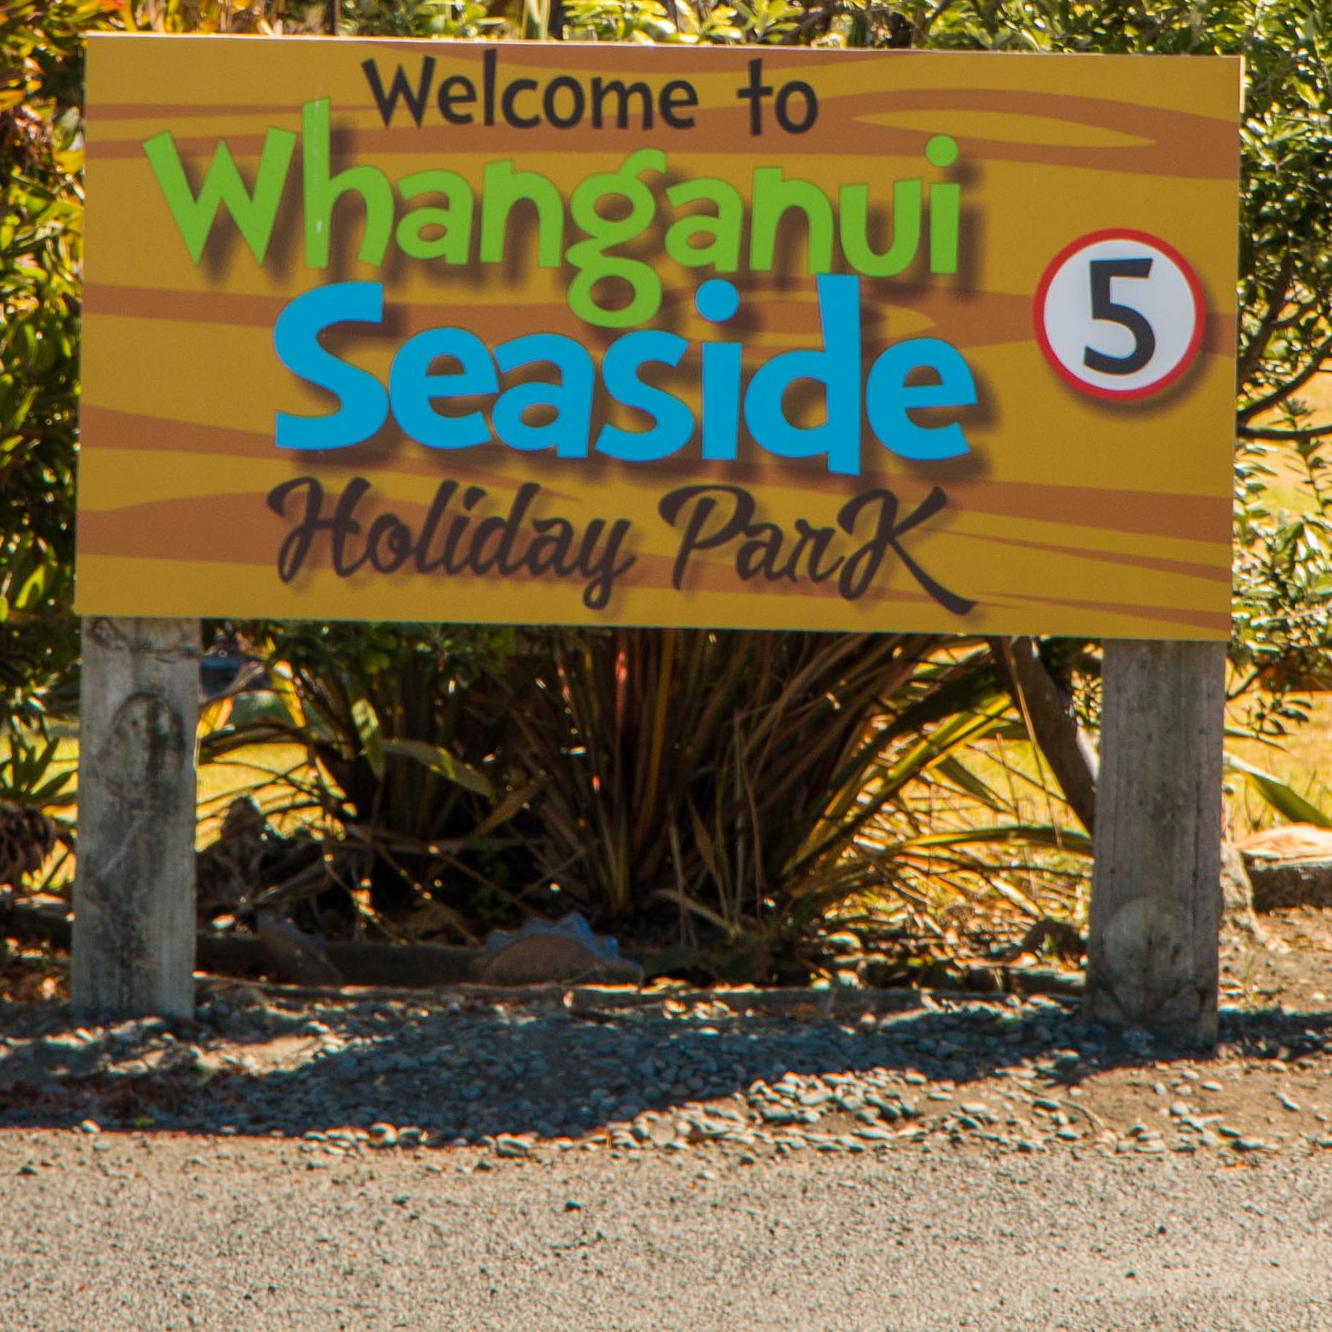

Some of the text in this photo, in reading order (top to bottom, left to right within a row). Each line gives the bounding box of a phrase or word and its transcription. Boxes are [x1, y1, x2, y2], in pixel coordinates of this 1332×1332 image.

[362, 48, 818, 135] Welcome to
[142, 96, 962, 329] Whanganui
[273, 273, 979, 476] Seaside
[1084, 259, 1155, 375] 5
[266, 475, 638, 610] Holiday
